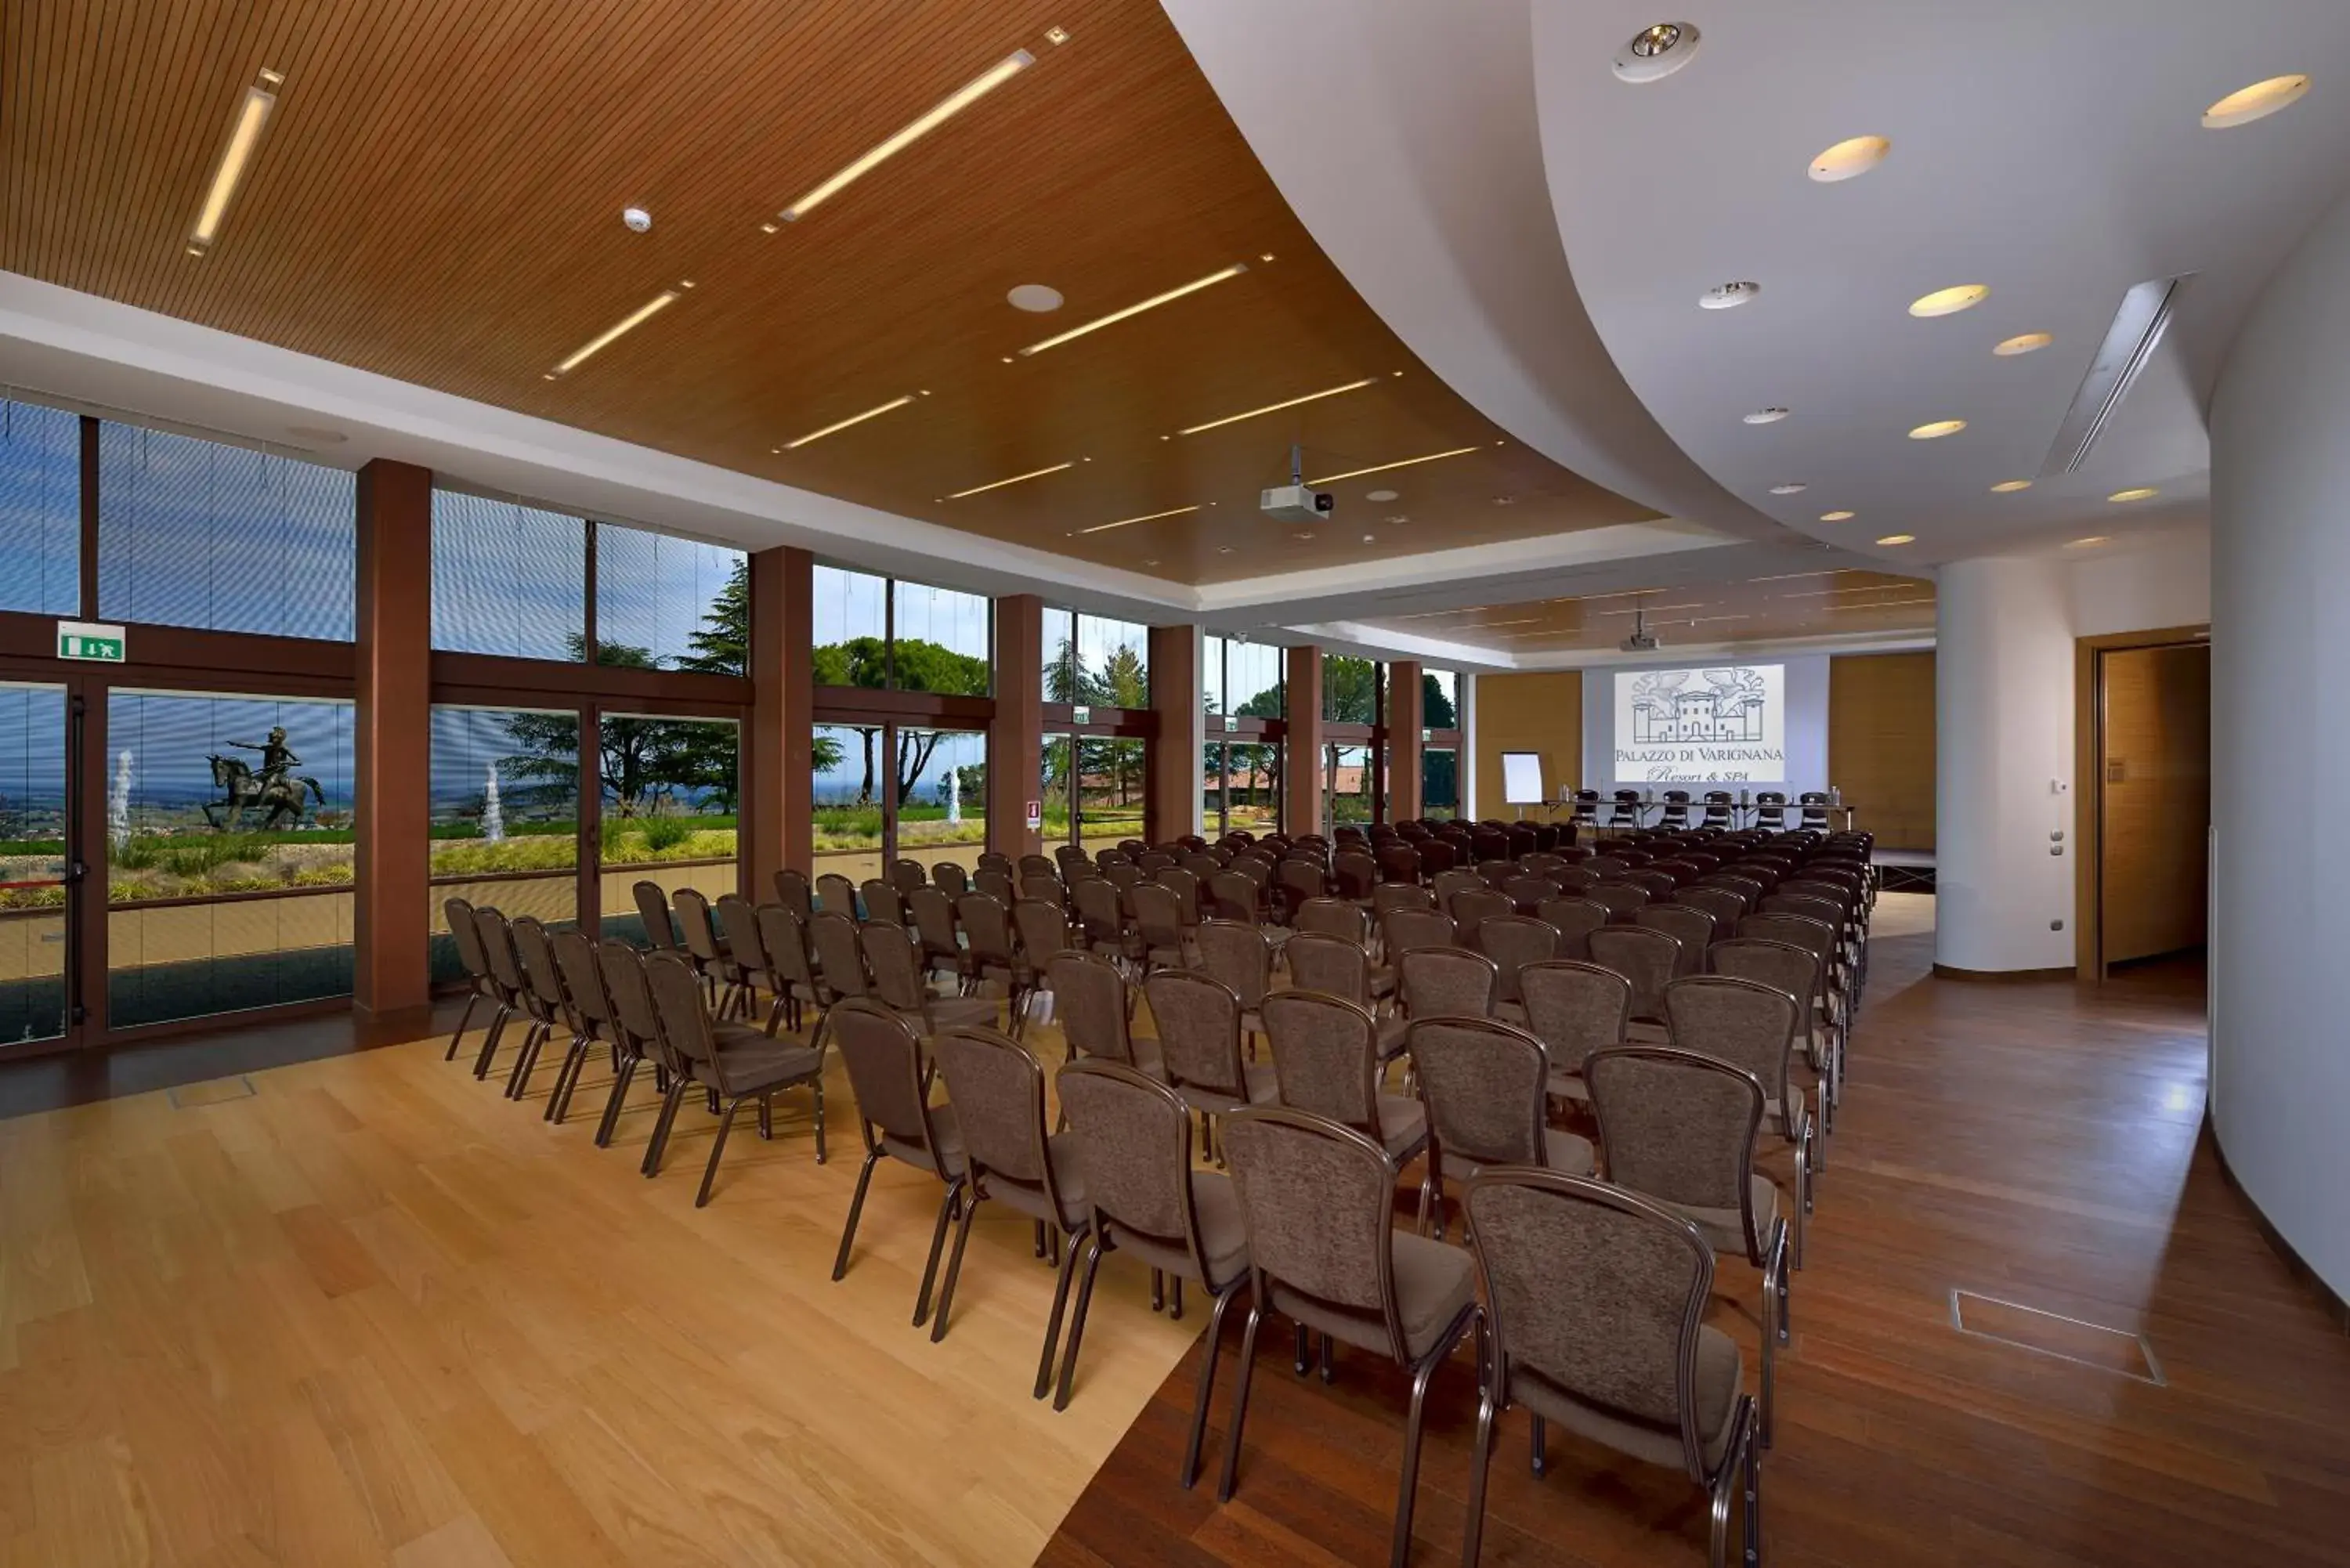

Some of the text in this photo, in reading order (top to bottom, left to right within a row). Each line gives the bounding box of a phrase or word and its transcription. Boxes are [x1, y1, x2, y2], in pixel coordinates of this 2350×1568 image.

[1616, 747, 1784, 761] PALAZZO DI VARIGNANA
[1706, 771, 1717, 781] &
[1723, 771, 1748, 781] SPA
